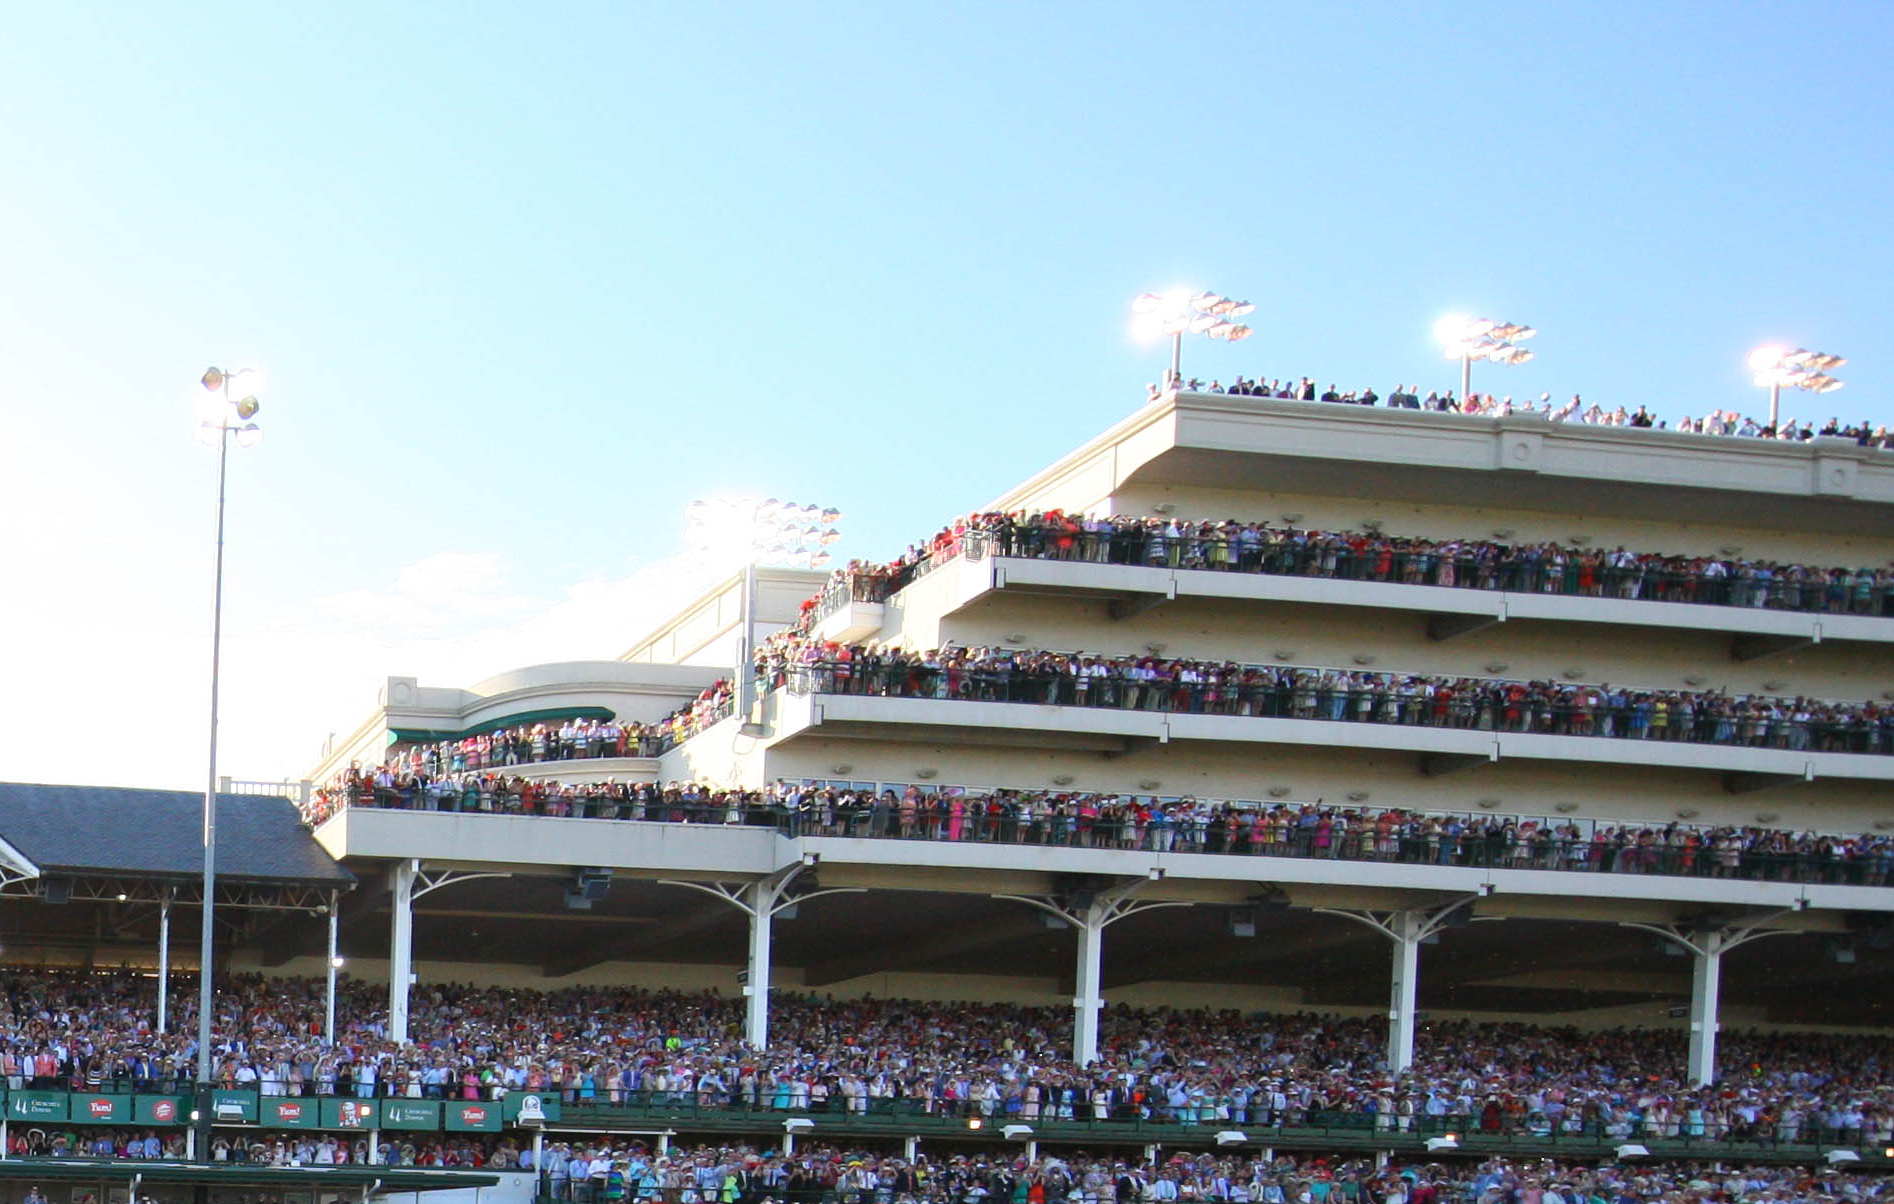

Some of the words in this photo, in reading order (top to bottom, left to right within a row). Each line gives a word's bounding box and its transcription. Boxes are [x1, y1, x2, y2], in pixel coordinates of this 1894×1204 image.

[91, 1102, 113, 1112] Yum!
[279, 1106, 301, 1117] Yum!
[462, 1110, 486, 1120] Yum!
